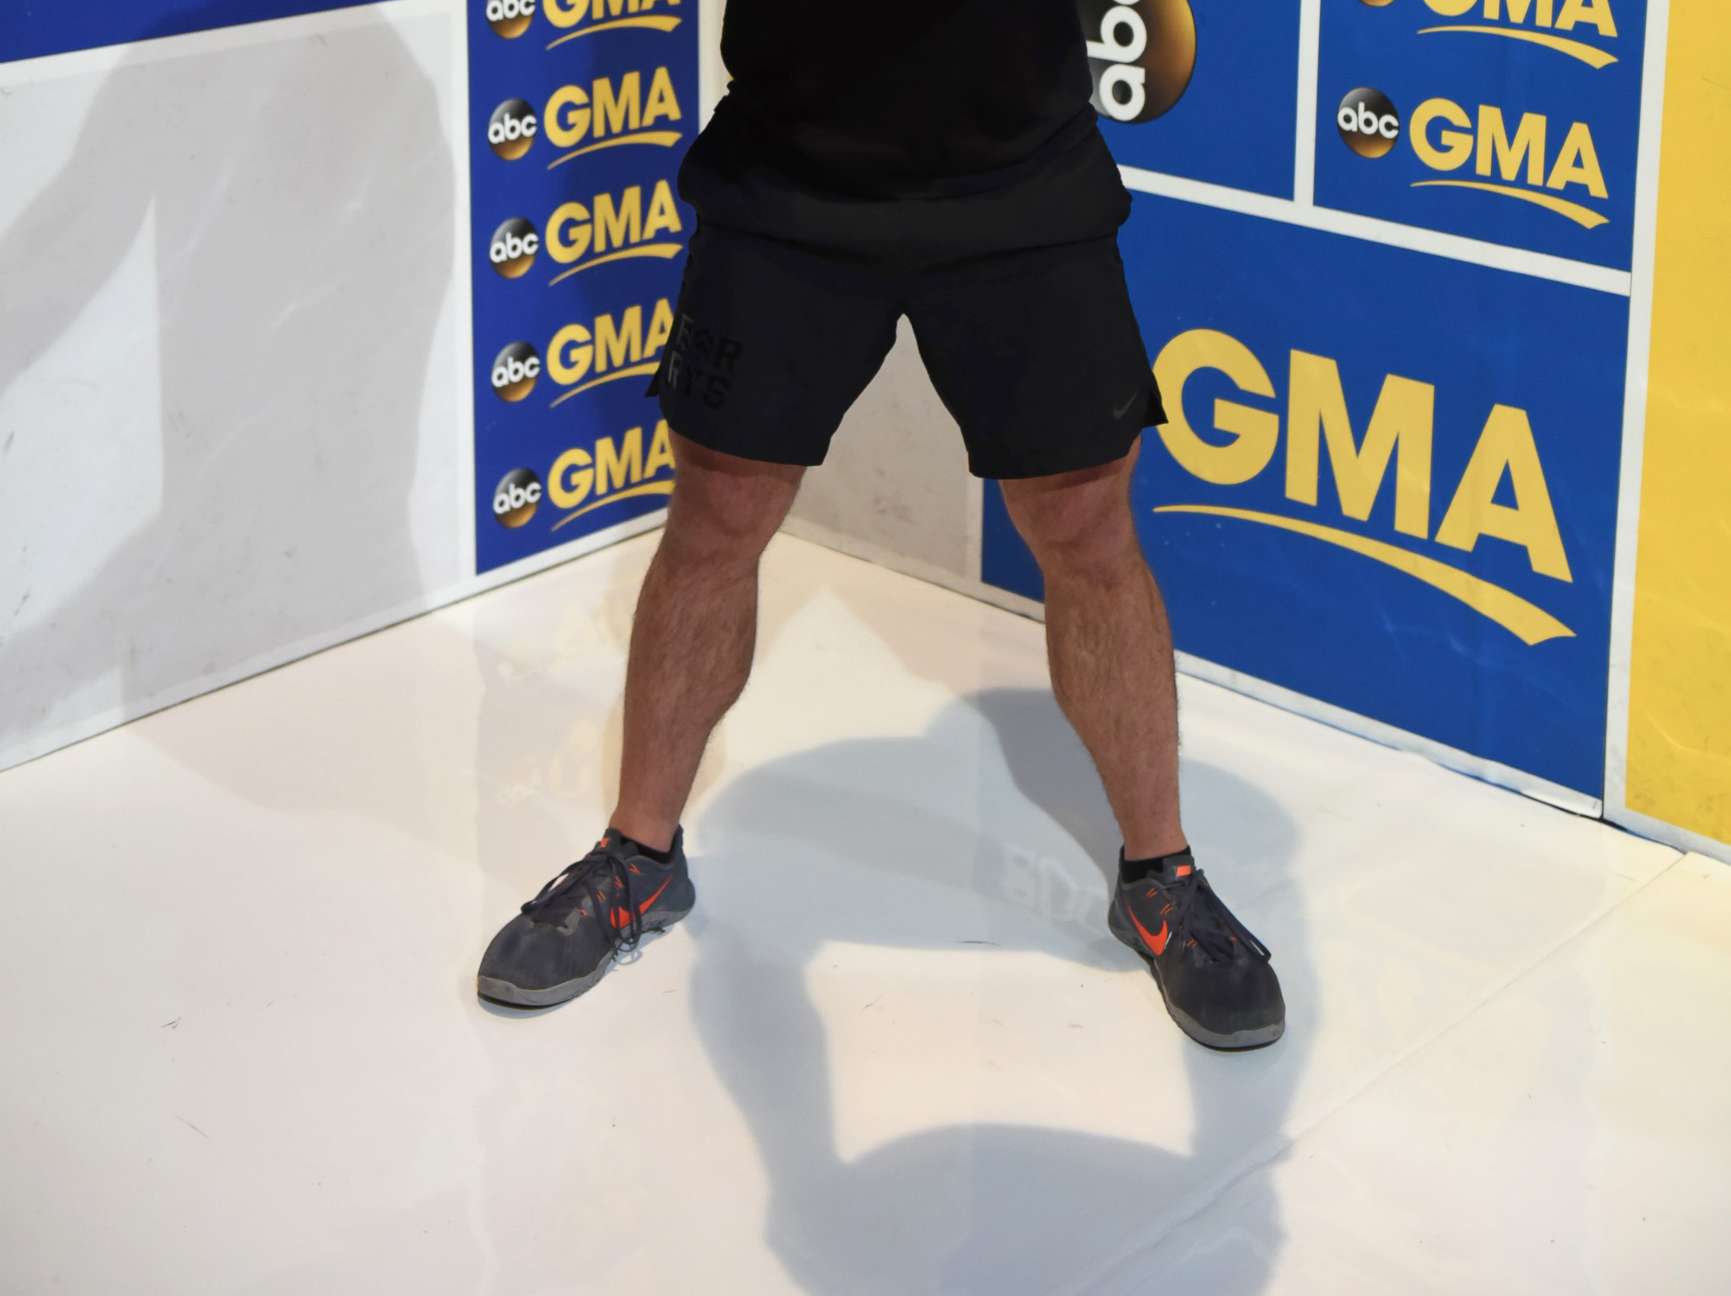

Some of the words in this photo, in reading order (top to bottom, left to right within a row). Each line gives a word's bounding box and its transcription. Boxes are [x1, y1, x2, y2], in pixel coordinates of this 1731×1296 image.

[488, 112, 538, 144] abc
[544, 67, 681, 147] GMA
[1337, 103, 1399, 140] abc
[1409, 97, 1608, 199] GMA
[490, 231, 540, 263] abc
[545, 179, 682, 264] GMA
[491, 354, 541, 388] abc
[546, 298, 674, 385] GMA
[493, 481, 542, 514] abc
[548, 419, 676, 509] GMA
[1152, 328, 1573, 583] GMA
